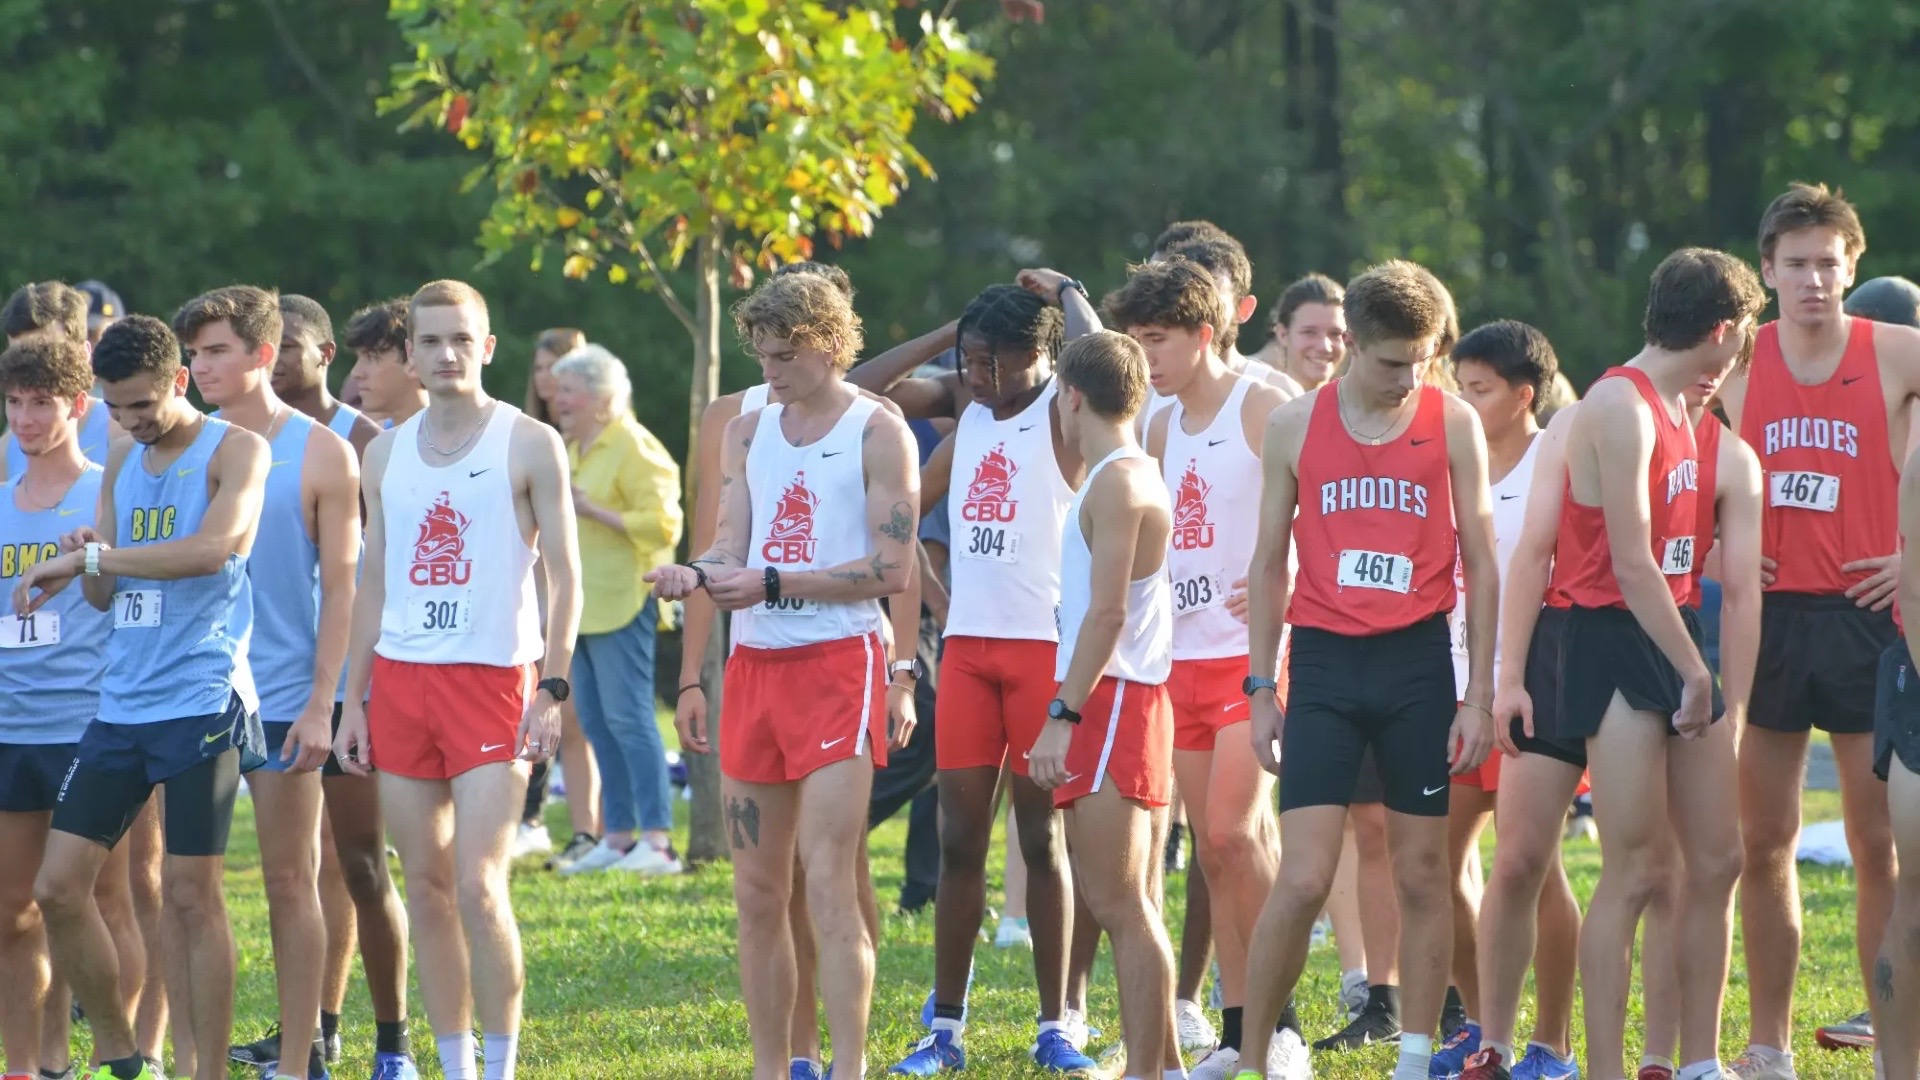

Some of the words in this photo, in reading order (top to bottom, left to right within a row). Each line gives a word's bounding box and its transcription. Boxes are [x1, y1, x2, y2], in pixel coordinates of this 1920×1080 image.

[1764, 416, 1858, 458] RHODES
[1320, 475, 1428, 518] RHODES
[1780, 473, 1825, 504] 467
[961, 502, 1016, 522] CBU
[762, 541, 816, 564] CBU
[969, 526, 1005, 556] 304
[1172, 526, 1214, 551] CBU
[1672, 538, 1691, 568] 46
[409, 562, 471, 586] CBU
[1354, 552, 1396, 586] 461
[124, 592, 143, 622] 76
[1174, 575, 1212, 610] 303
[17, 613, 38, 643] 71
[423, 600, 459, 630] 301
